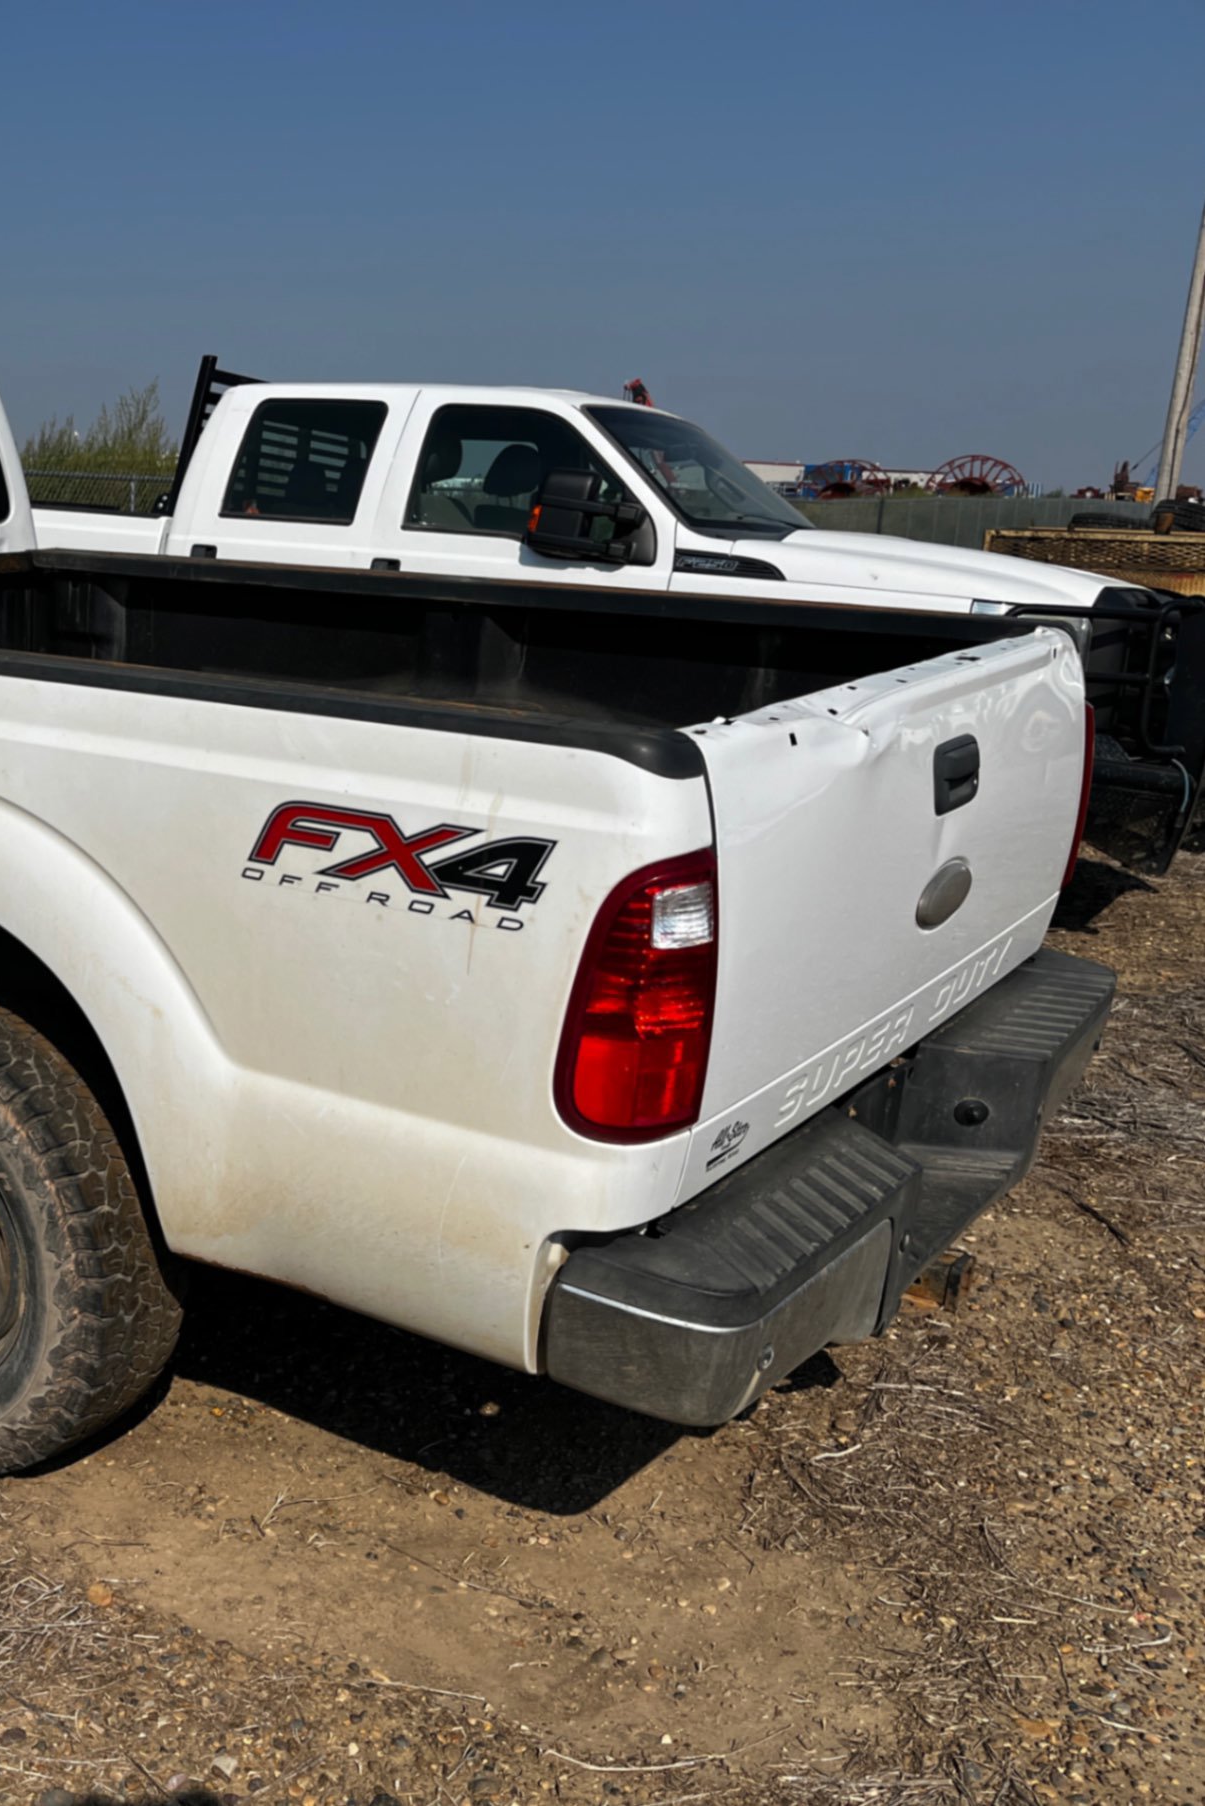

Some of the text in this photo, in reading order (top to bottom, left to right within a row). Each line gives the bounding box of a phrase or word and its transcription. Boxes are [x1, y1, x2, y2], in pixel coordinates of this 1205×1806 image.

[248, 801, 558, 912] FX4
[774, 936, 1013, 1128] SUPER DUTY
